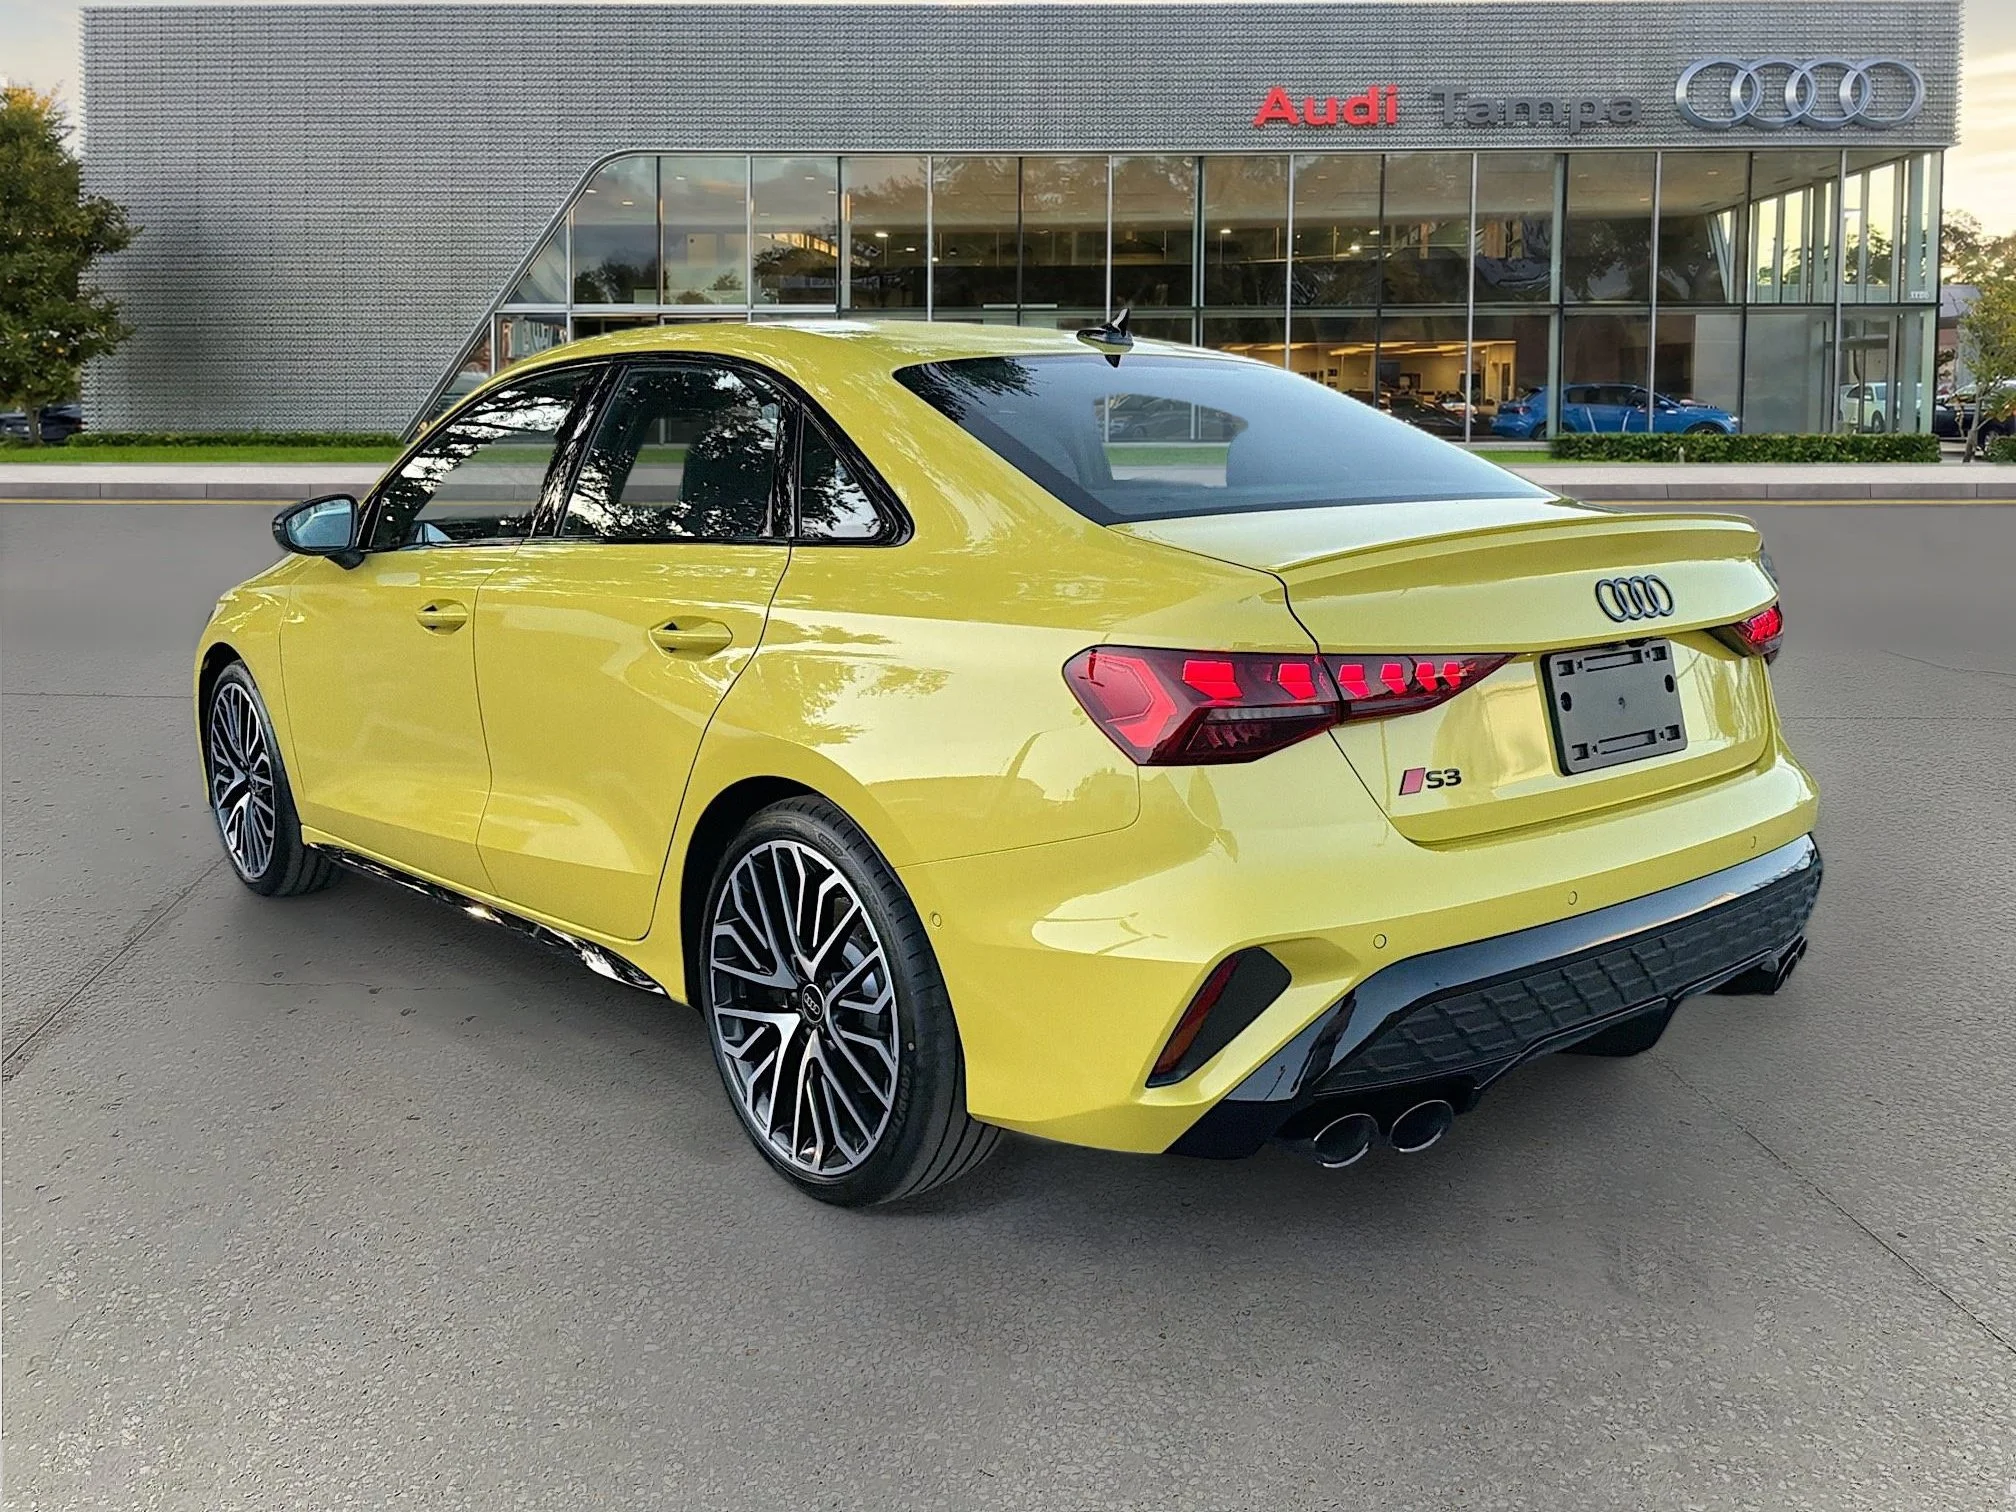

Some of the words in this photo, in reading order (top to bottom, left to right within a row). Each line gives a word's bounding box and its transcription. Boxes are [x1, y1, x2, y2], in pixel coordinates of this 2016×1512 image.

[1253, 84, 1398, 127] Audi
[1431, 86, 1641, 134] Tampa
[1425, 768, 1462, 789] S3
